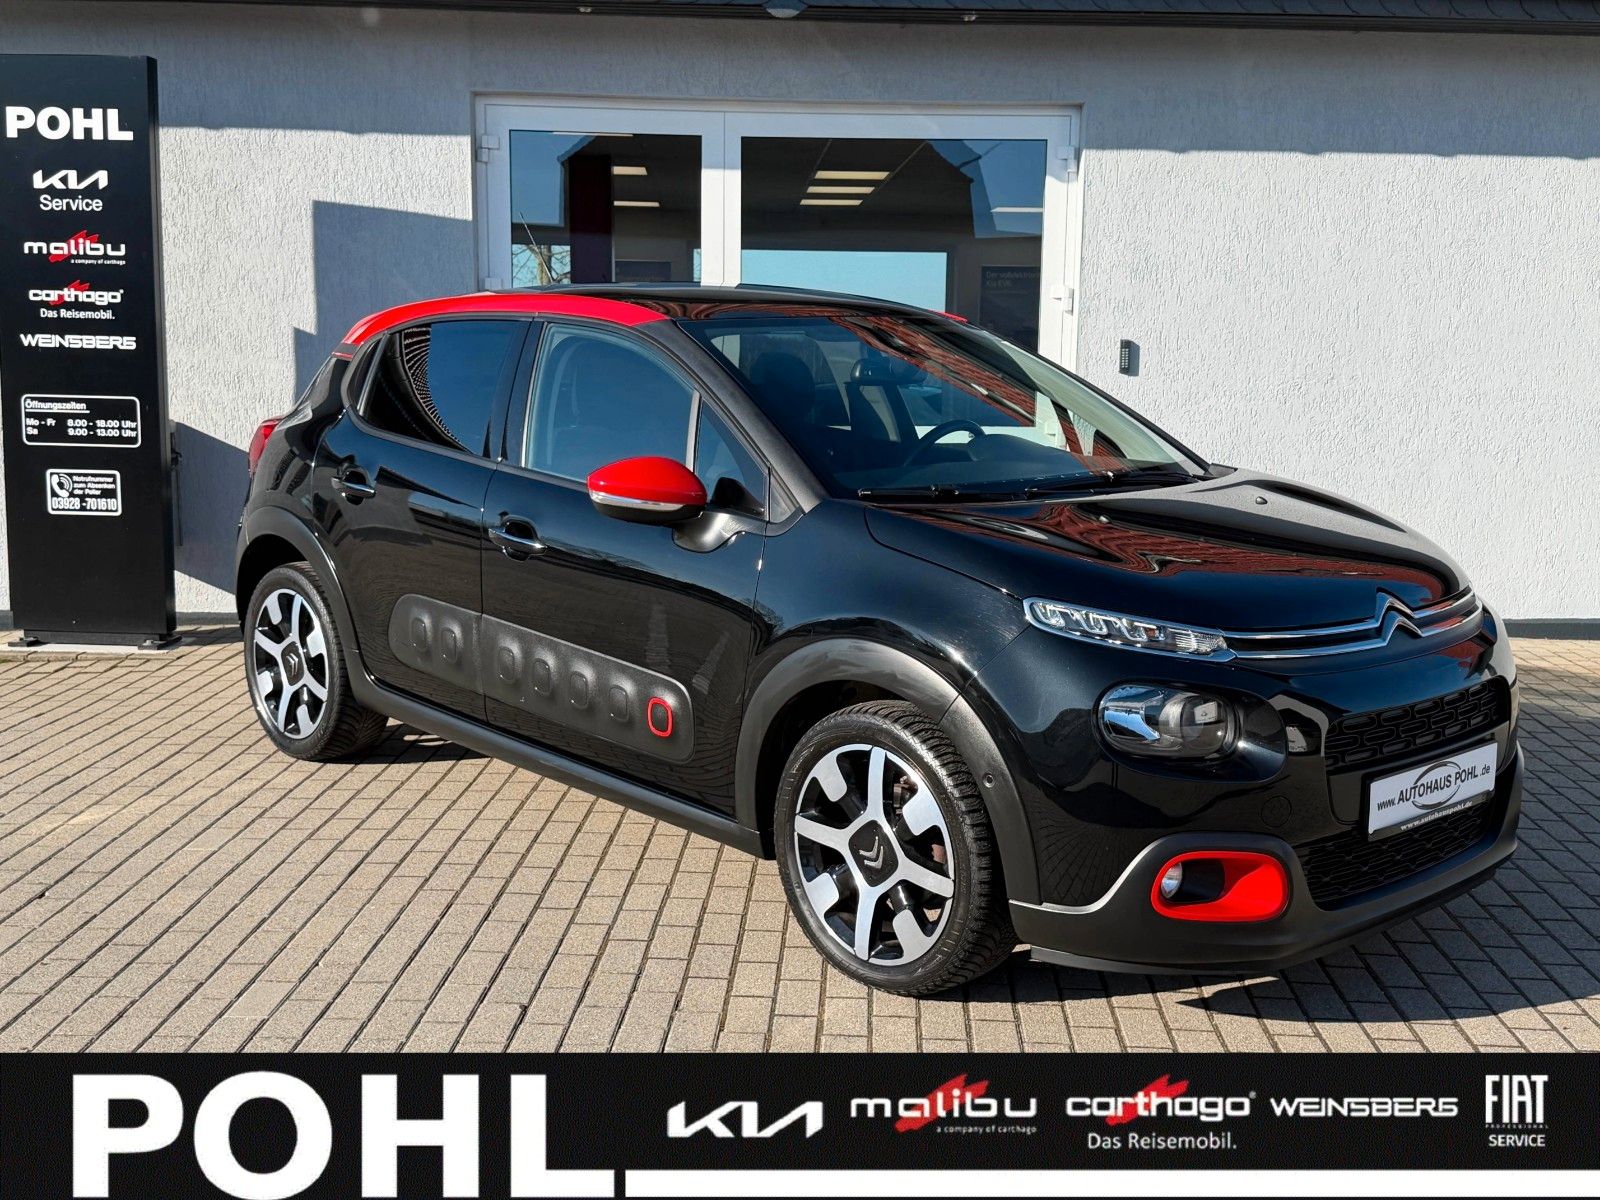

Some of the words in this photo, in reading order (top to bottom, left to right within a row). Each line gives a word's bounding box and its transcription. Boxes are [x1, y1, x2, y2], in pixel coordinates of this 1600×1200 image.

[5, 106, 134, 141] POHL
[33, 169, 108, 189] KIA
[39, 194, 103, 211] Service
[23, 238, 126, 256] malibu
[40, 308, 58, 318] Das
[60, 308, 116, 320] Reisemobil.
[25, 399, 87, 410] Öffnungszeiten
[26, 418, 40, 426] Mo
[46, 418, 56, 426] Fr
[95, 419, 120, 428] 18.00
[121, 420, 137, 429] Uhr
[26, 426, 38, 435] Sa
[67, 427, 88, 436] 9.00
[96, 428, 120, 437] 13.00
[121, 429, 137, 438] Uhr
[1377, 797, 1396, 812] www.
[1397, 774, 1452, 805] AUTOHAUS
[1454, 766, 1479, 786] POHL
[1480, 764, 1491, 776] .de
[1400, 801, 1473, 831] www.autohauspohl.de
